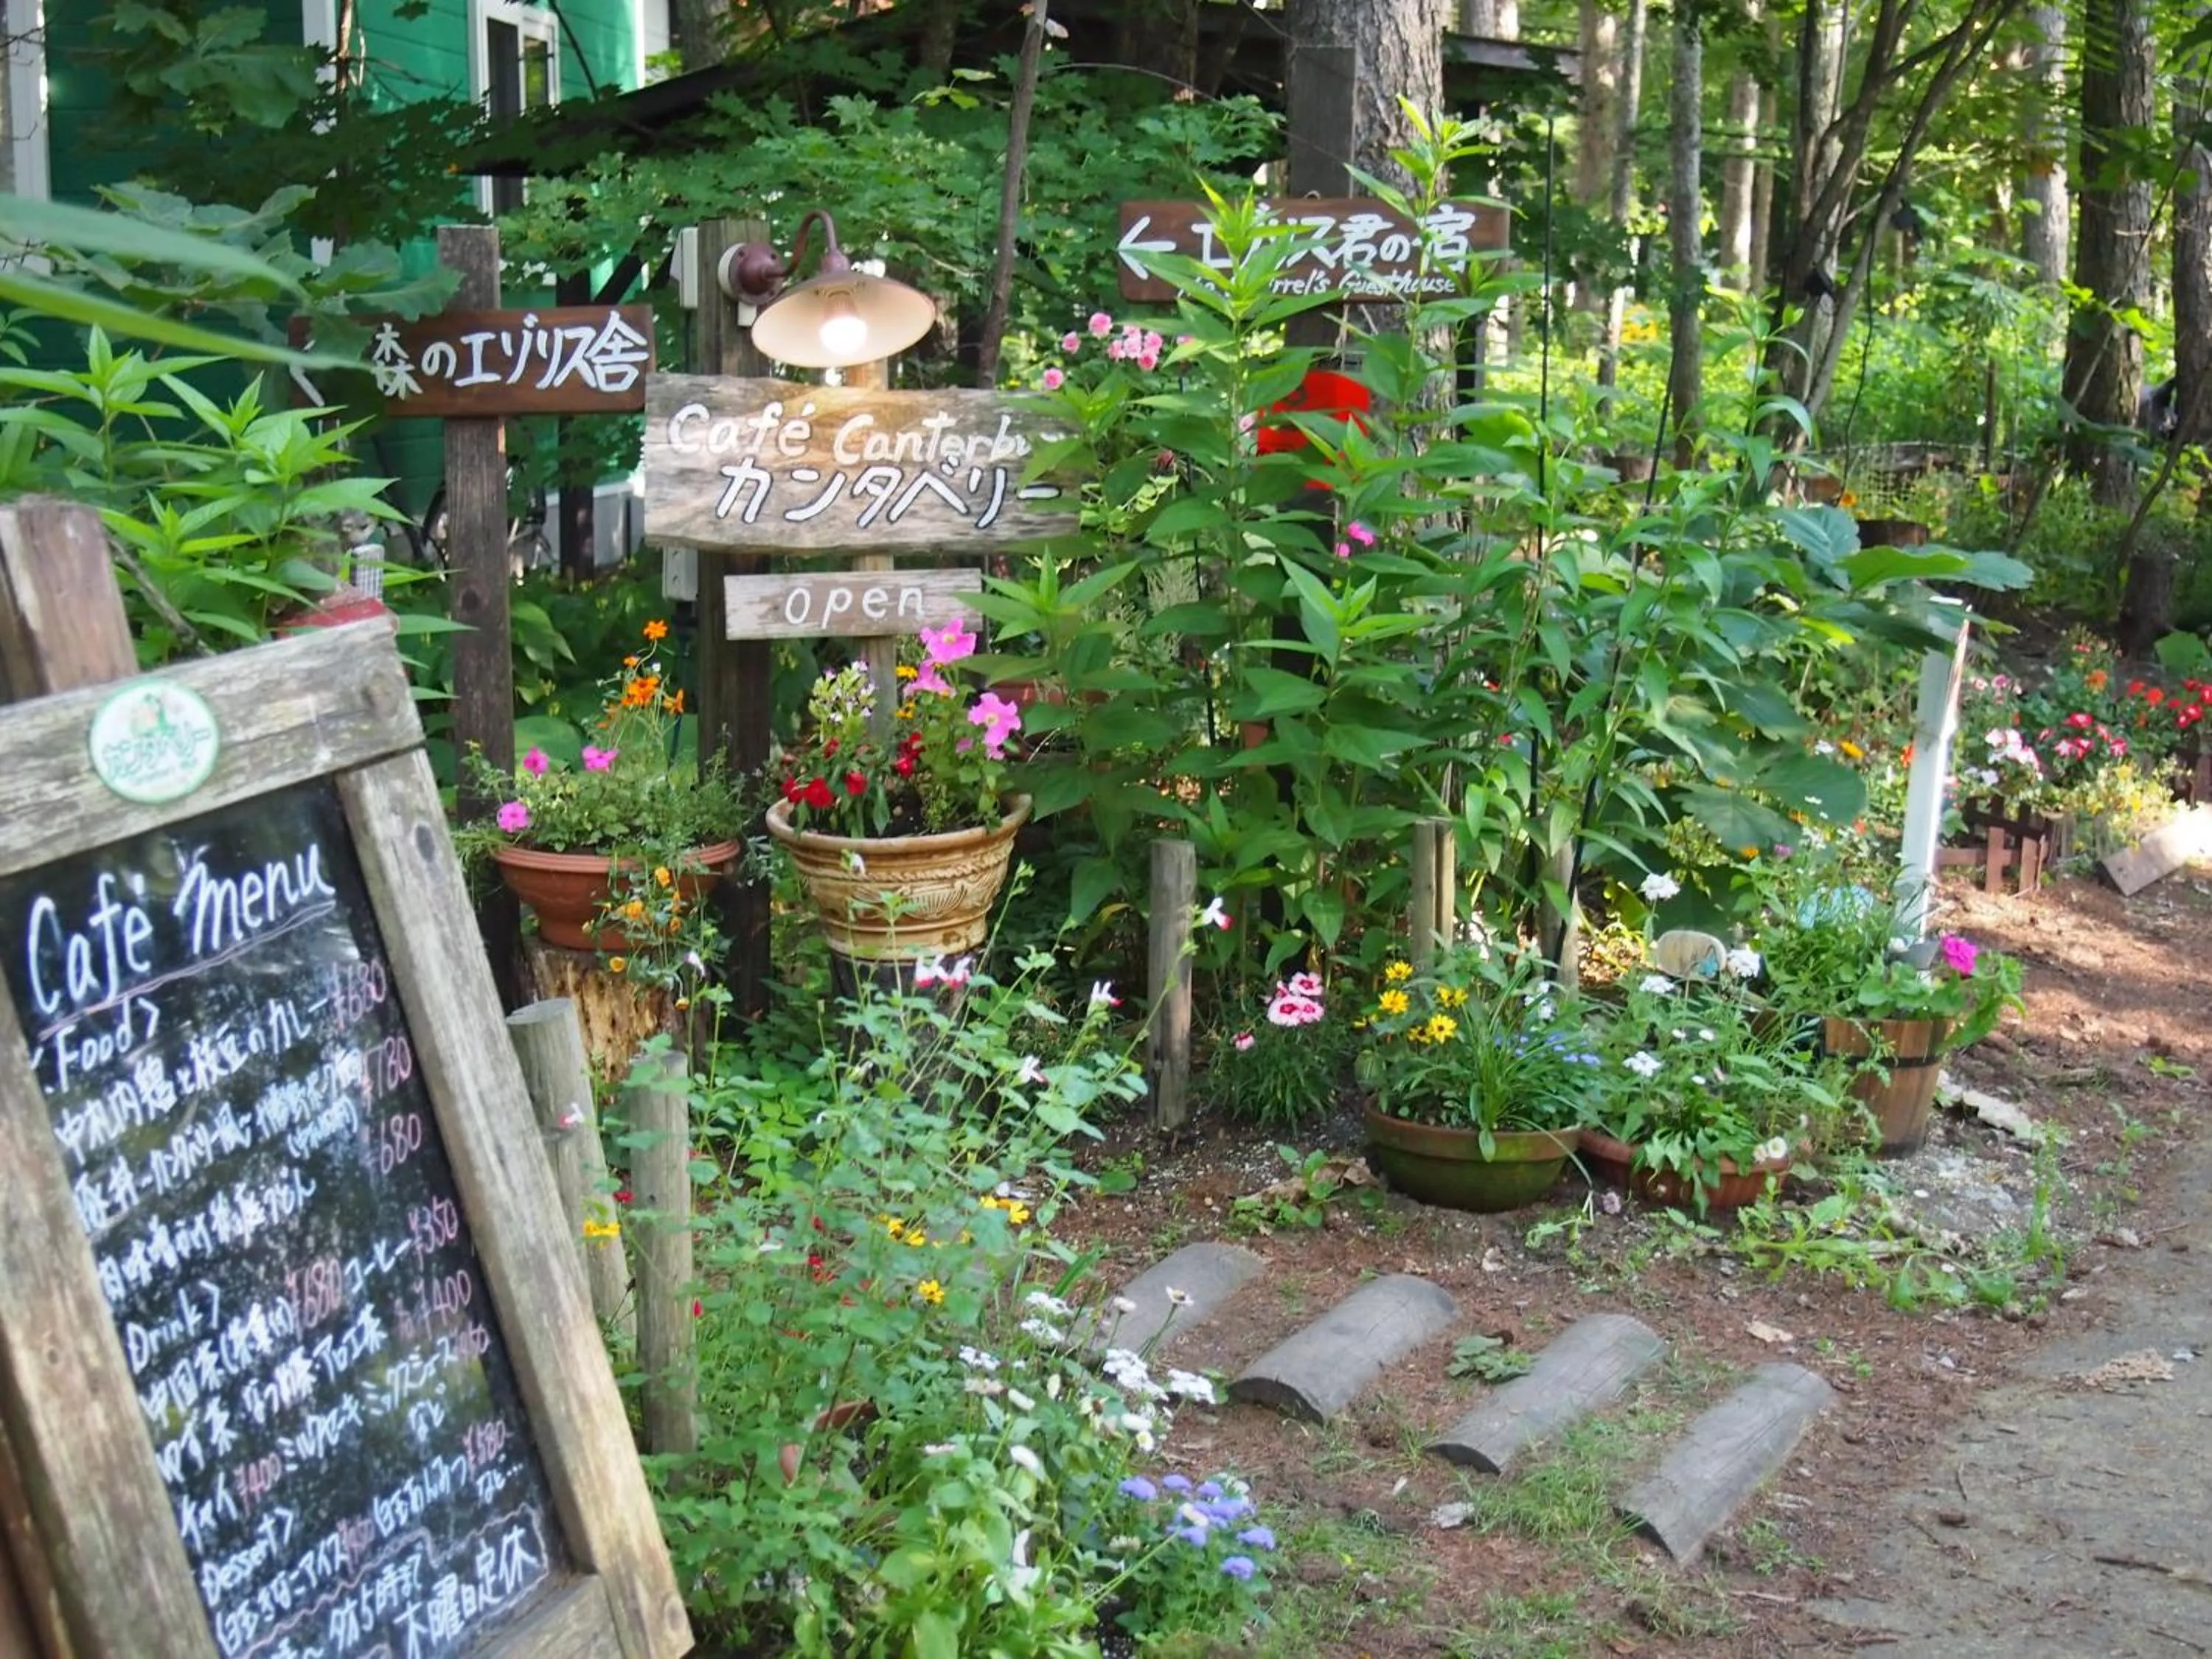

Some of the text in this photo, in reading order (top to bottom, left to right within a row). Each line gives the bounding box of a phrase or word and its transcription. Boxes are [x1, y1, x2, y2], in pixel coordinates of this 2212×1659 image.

[372, 310, 650, 400] 森のエゾリス舎
[667, 400, 1078, 466] Café Canterbu
[714, 456, 1062, 529] カンタベリー
[345, 1239, 411, 1294] コーヒー
[393, 1526, 538, 1659] 木曜日定休
